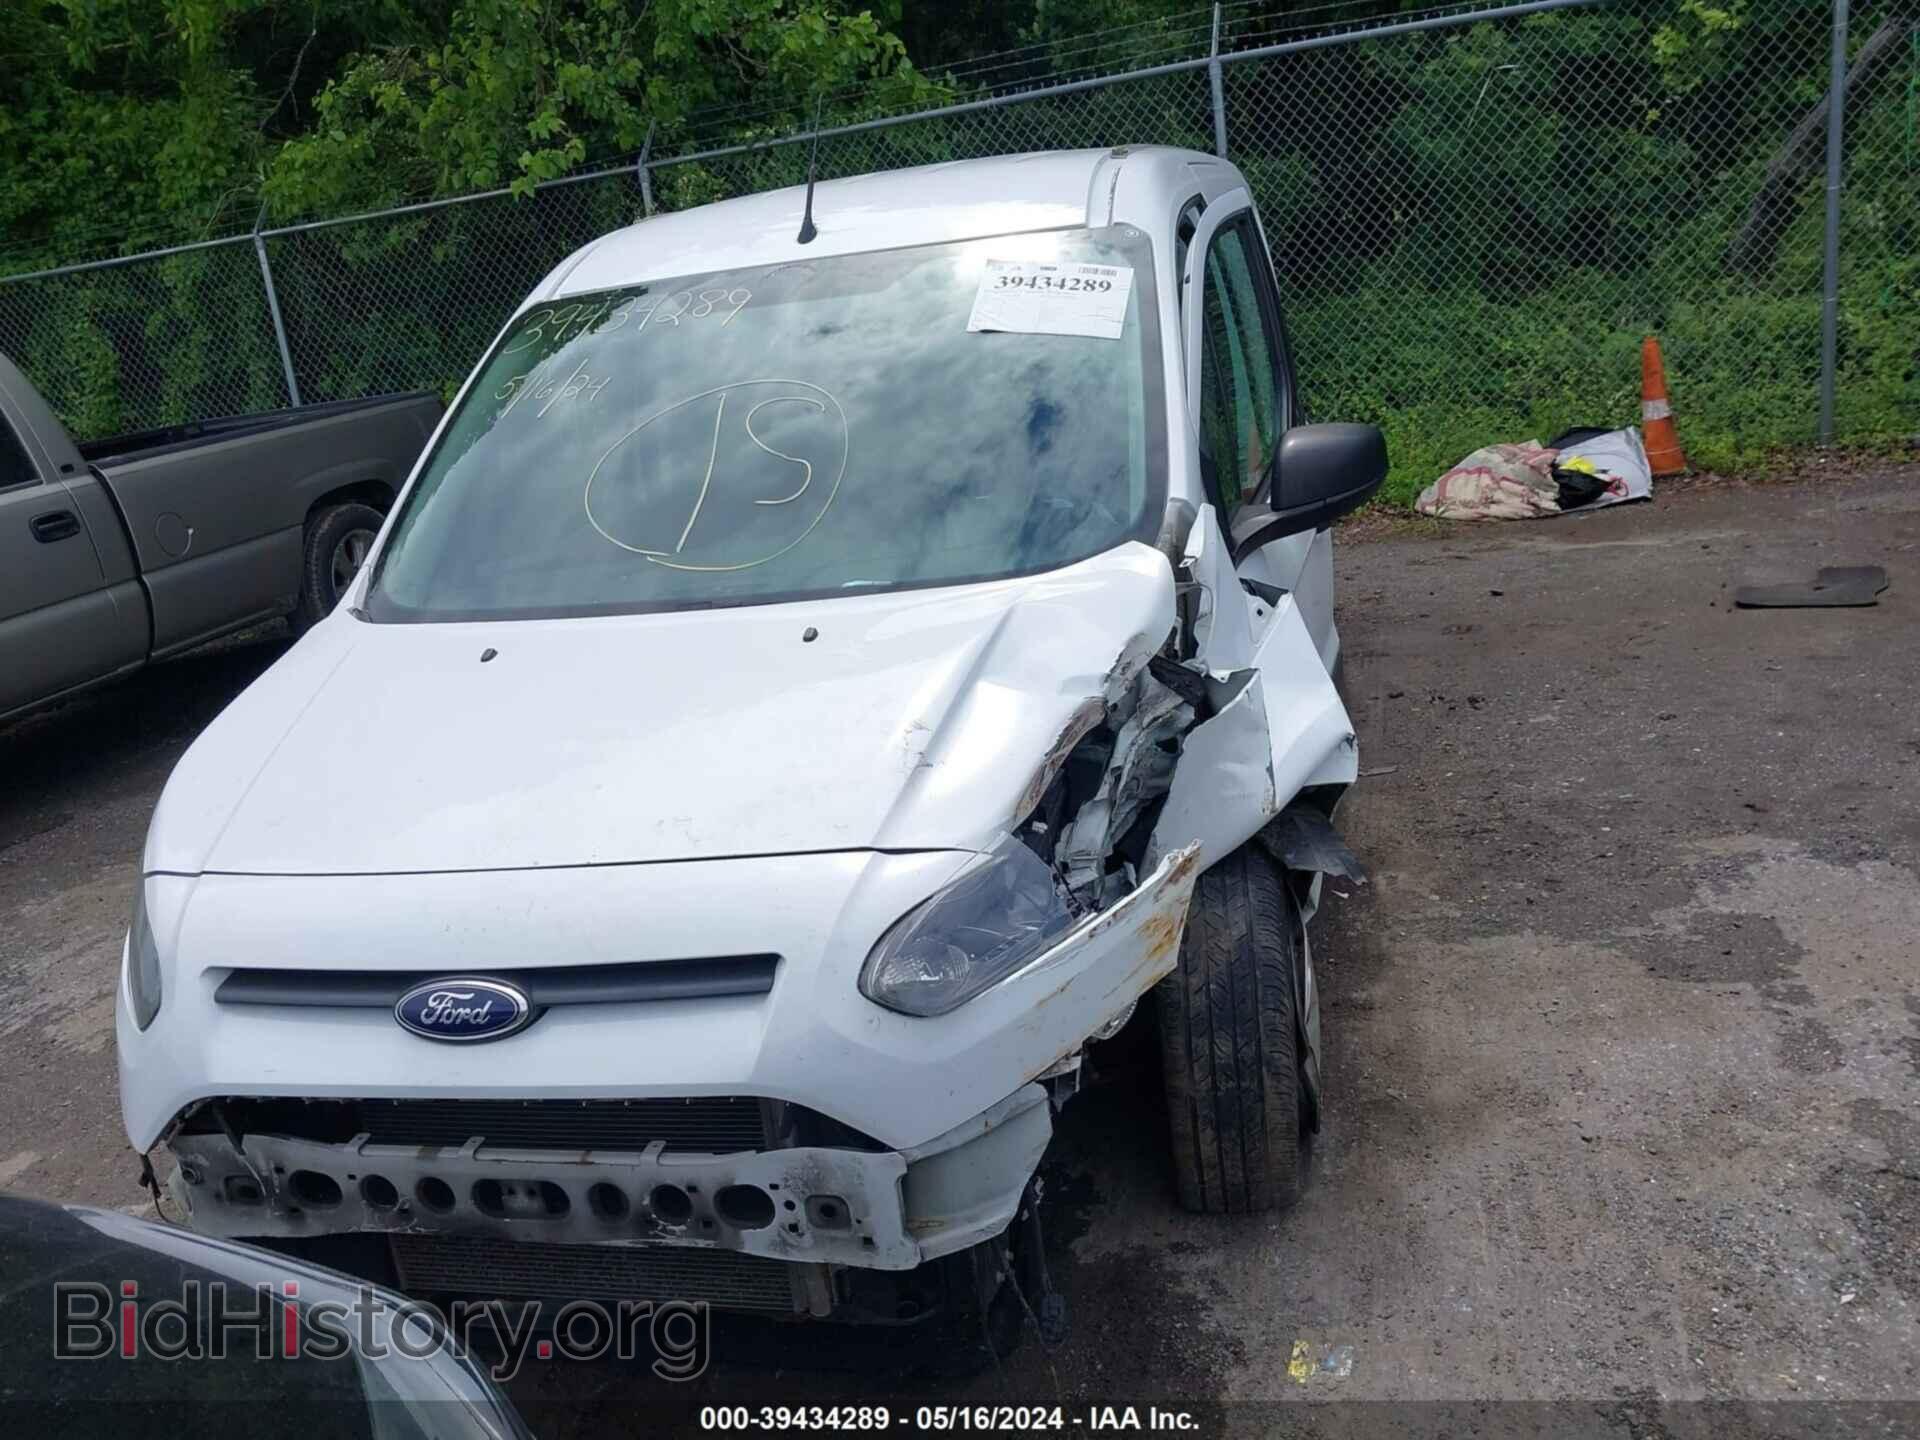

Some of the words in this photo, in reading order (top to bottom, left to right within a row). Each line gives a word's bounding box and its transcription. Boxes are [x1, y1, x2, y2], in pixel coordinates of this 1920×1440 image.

[994, 275, 1113, 293] 39434289
[503, 288, 752, 354] 39434289
[494, 358, 611, 420] 5/16/24
[420, 991, 494, 1025] Ford
